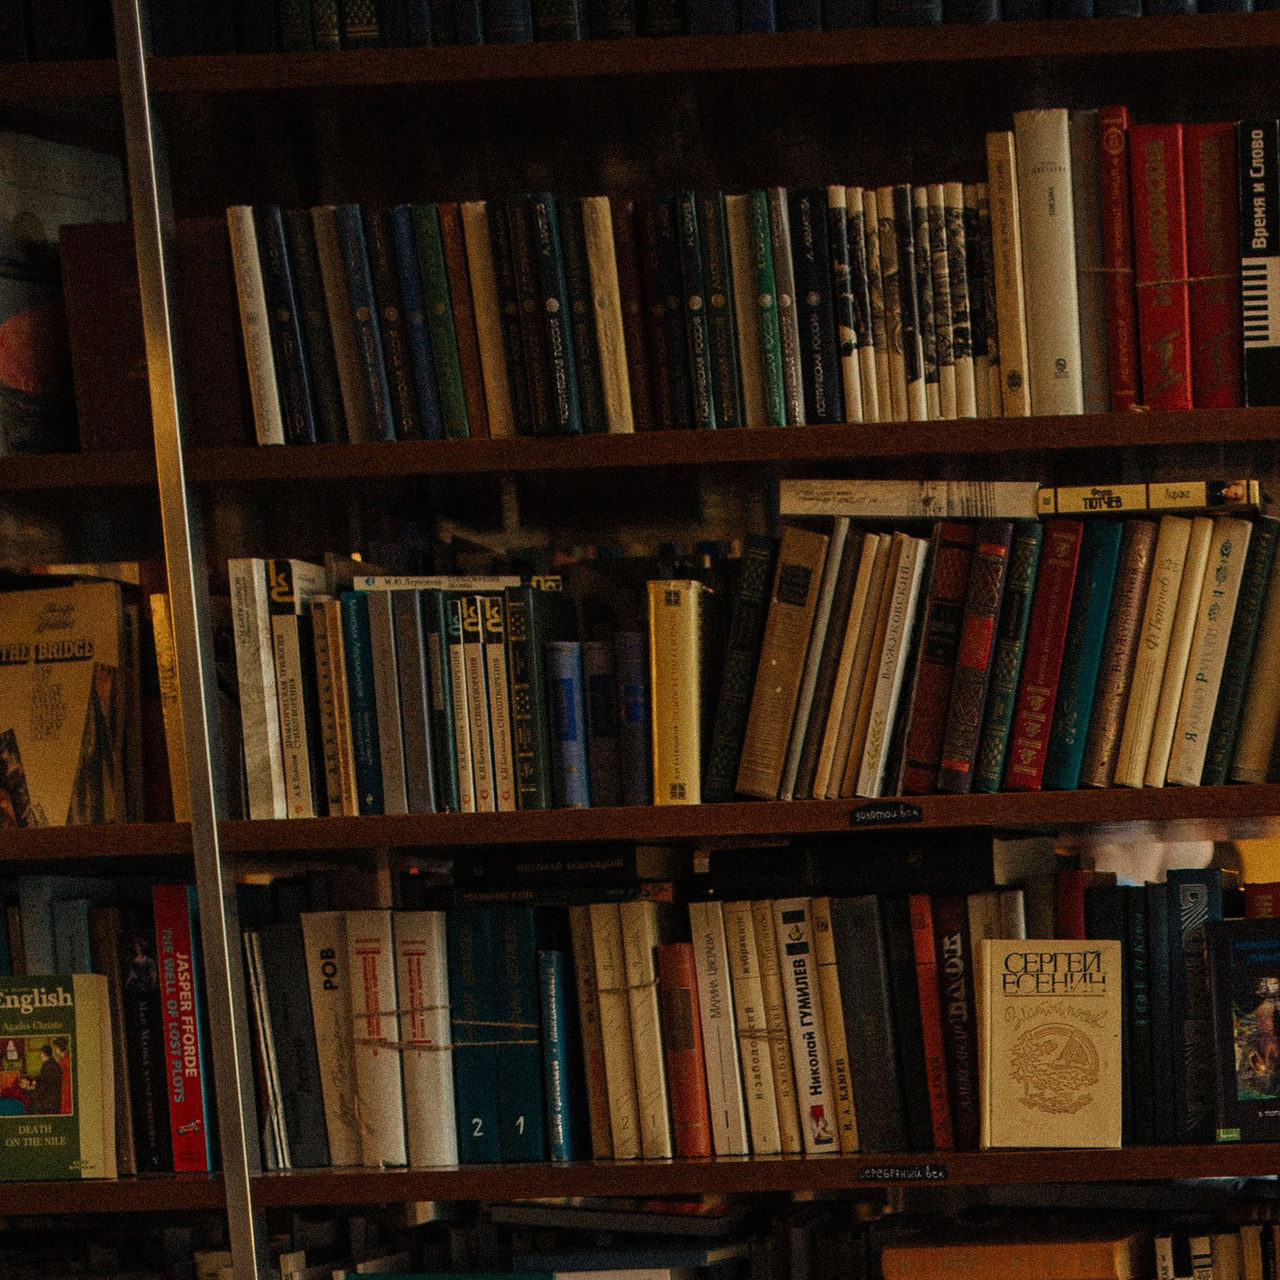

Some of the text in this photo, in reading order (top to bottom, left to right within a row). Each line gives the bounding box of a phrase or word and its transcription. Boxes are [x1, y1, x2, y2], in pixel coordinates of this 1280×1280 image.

[1248, 128, 1270, 250] Время и Слово
[34, 641, 94, 661] BRIDGE
[1003, 950, 1102, 975] СЕРГЕЙ
[1002, 971, 1107, 995] ЕСЕНИН
[160, 927, 186, 1104] THE WELL OF LOST PLOTS
[175, 951, 198, 1079] JASPER FFORDE
[792, 958, 823, 1097] Николай ГУМИЛЕВ
[17, 1125, 53, 1136] DEATH
[470, 1115, 485, 1138] 2
[514, 1113, 526, 1135] 1
[5, 1136, 67, 1148] ON THE NILE
